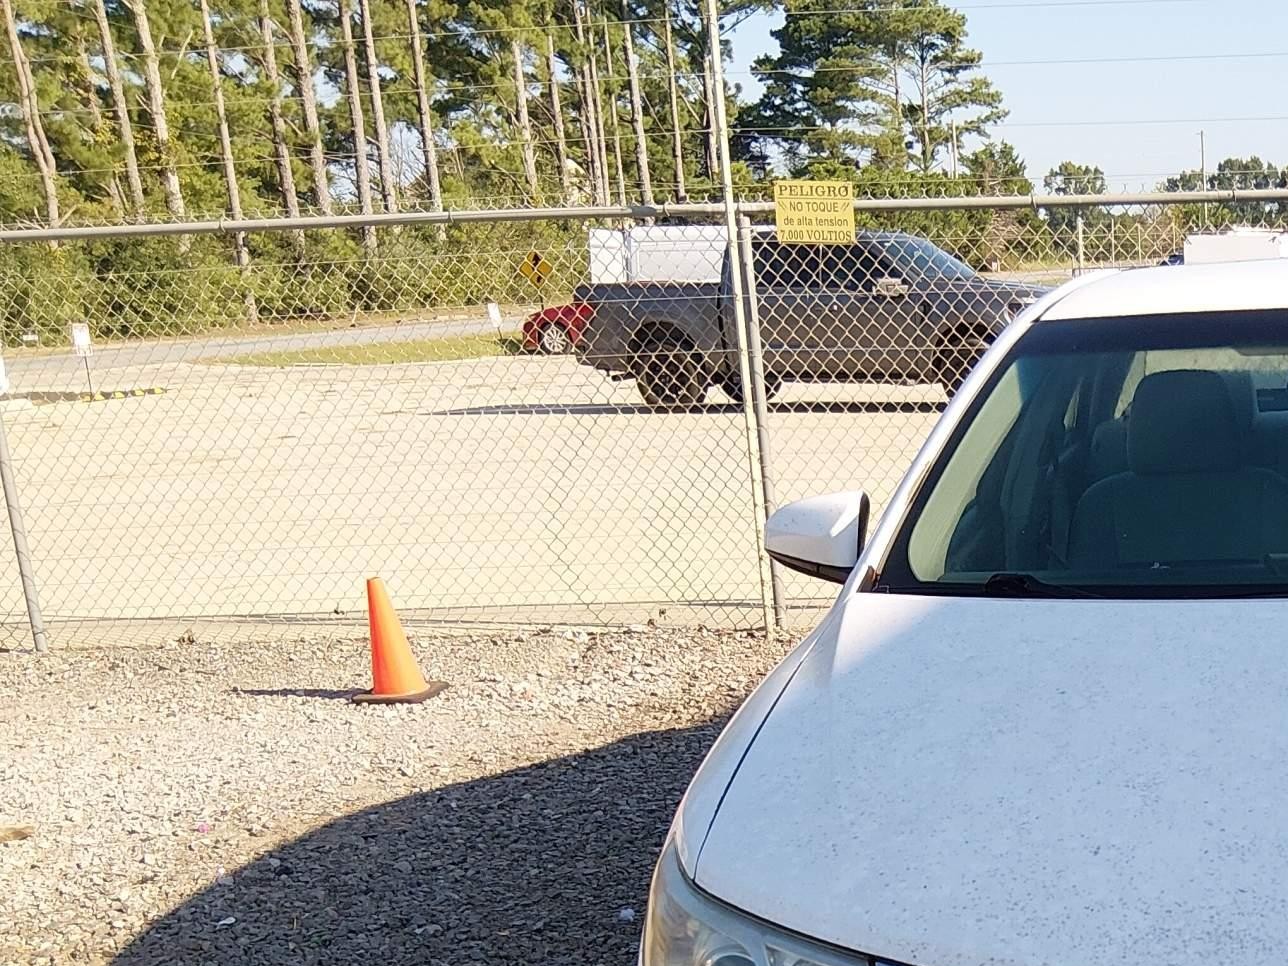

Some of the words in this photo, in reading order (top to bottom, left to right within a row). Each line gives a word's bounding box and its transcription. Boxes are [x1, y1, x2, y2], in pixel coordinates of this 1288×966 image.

[779, 185, 848, 197] PELIGRO
[789, 202, 803, 212] NO
[806, 202, 839, 212] TOQUE
[783, 216, 795, 226] de
[797, 216, 813, 226] alta
[806, 230, 852, 241] VOLTIOS
